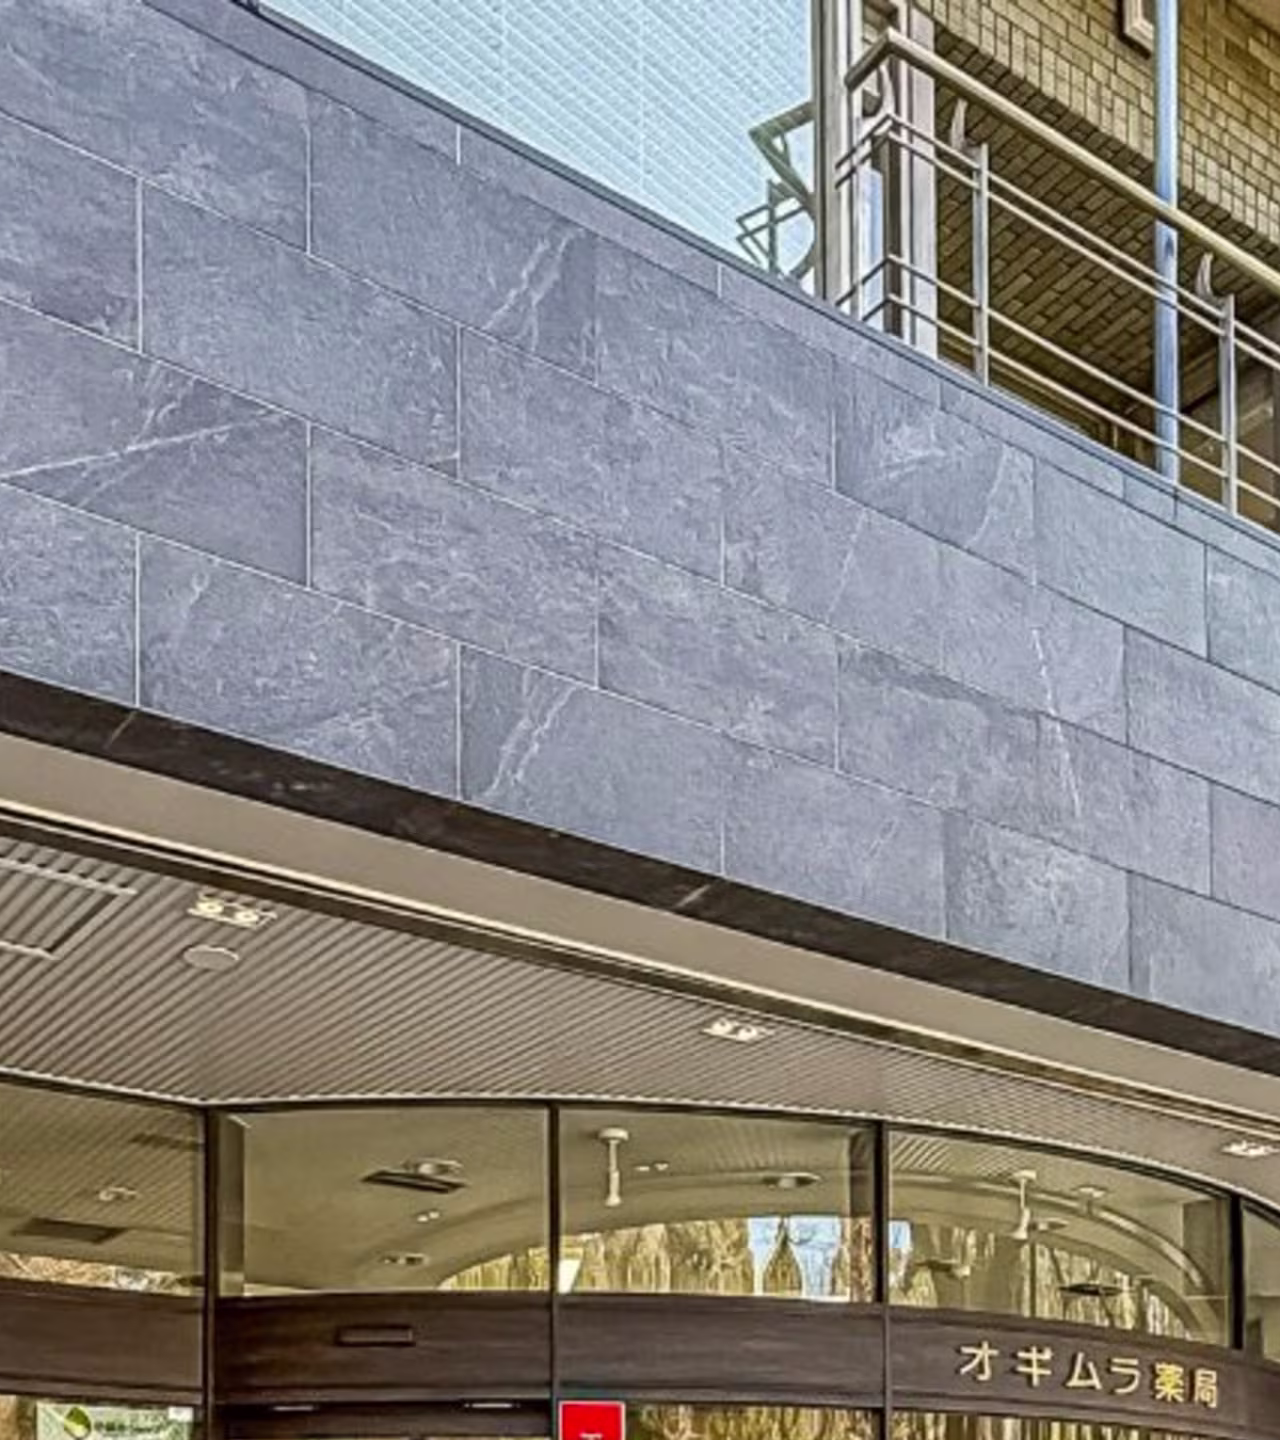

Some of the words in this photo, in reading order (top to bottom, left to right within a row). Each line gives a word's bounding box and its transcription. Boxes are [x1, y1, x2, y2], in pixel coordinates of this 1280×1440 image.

[959, 1340, 1218, 1408] オギムラ薬局
